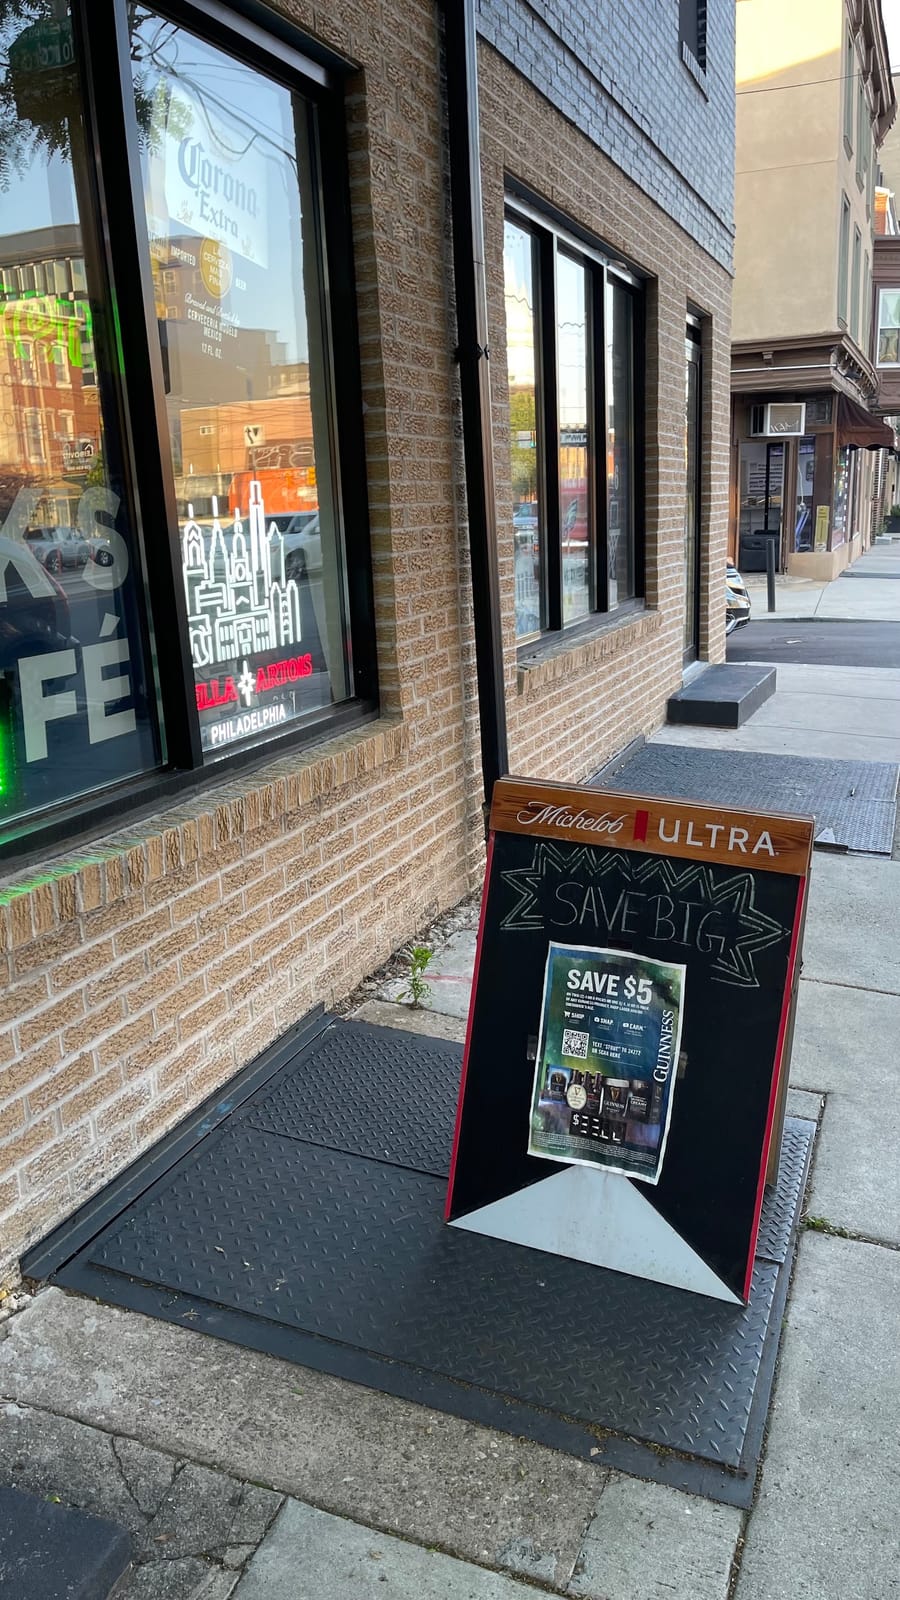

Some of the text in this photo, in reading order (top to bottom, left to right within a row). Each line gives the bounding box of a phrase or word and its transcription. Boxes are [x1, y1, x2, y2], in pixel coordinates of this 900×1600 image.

[177, 137, 257, 218] Corona
[199, 190, 239, 239] Extra
[171, 245, 196, 267] IMPORTED
[255, 653, 313, 694] ARTOIS
[211, 703, 287, 745] PHILADELPHIA
[516, 801, 775, 857] Michelob ULTRA
[550, 881, 726, 953] SAVE BIG
[566, 968, 653, 1005] SAVE $5
[652, 1009, 675, 1083] GUINNESS
